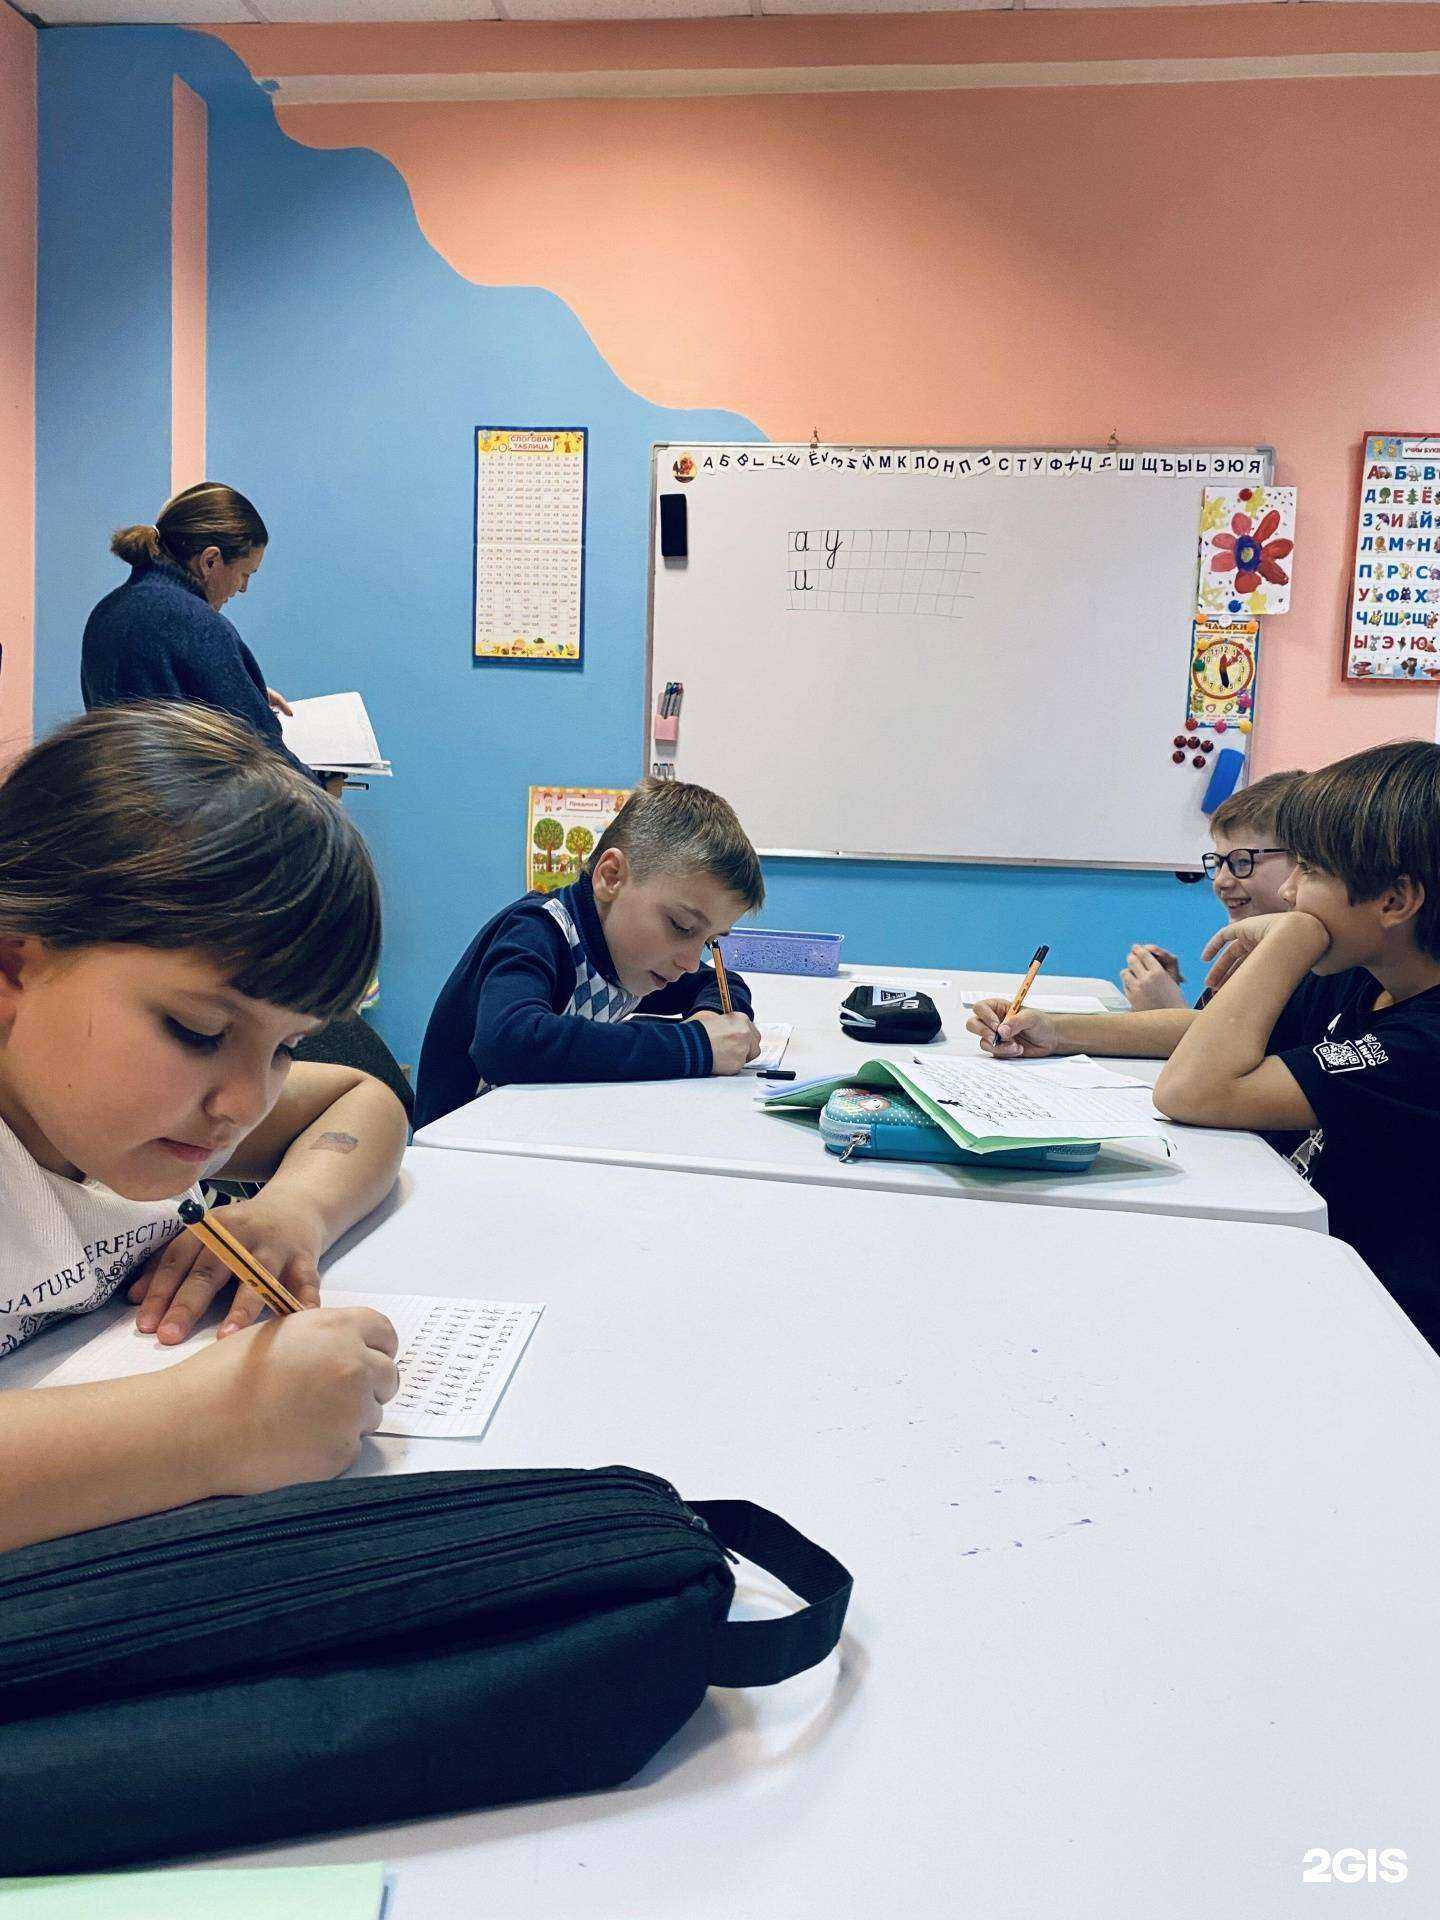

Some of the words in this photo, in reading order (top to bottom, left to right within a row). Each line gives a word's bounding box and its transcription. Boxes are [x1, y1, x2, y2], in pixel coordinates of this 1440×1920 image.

[1367, 465, 1379, 479] А
[1395, 466, 1407, 480] Б
[1424, 466, 1436, 480] В
[1365, 489, 1376, 503] Д
[1393, 490, 1404, 503] Е
[1422, 487, 1432, 503] Ё
[1363, 513, 1373, 527] З
[1391, 513, 1403, 527] И
[1420, 511, 1432, 528] Й
[1361, 537, 1373, 551] Л
[1389, 537, 1404, 551] М
[1417, 538, 1431, 551] Н
[1359, 564, 1371, 578] П
[1387, 565, 1398, 578] Р
[1416, 566, 1428, 579] С
[1358, 588, 1370, 601] У
[1386, 589, 1399, 602] Ф
[1414, 589, 1428, 603] Х
[1205, 622, 1247, 631] ЧАИКИ
[1356, 612, 1367, 625] Ч
[1384, 612, 1398, 626] Ш
[1412, 613, 1427, 626] Щ
[1354, 635, 1367, 648] Ы
[1382, 636, 1394, 649] Э
[1411, 637, 1427, 650] Ю
[83, 1222, 157, 1264] ERFECT
